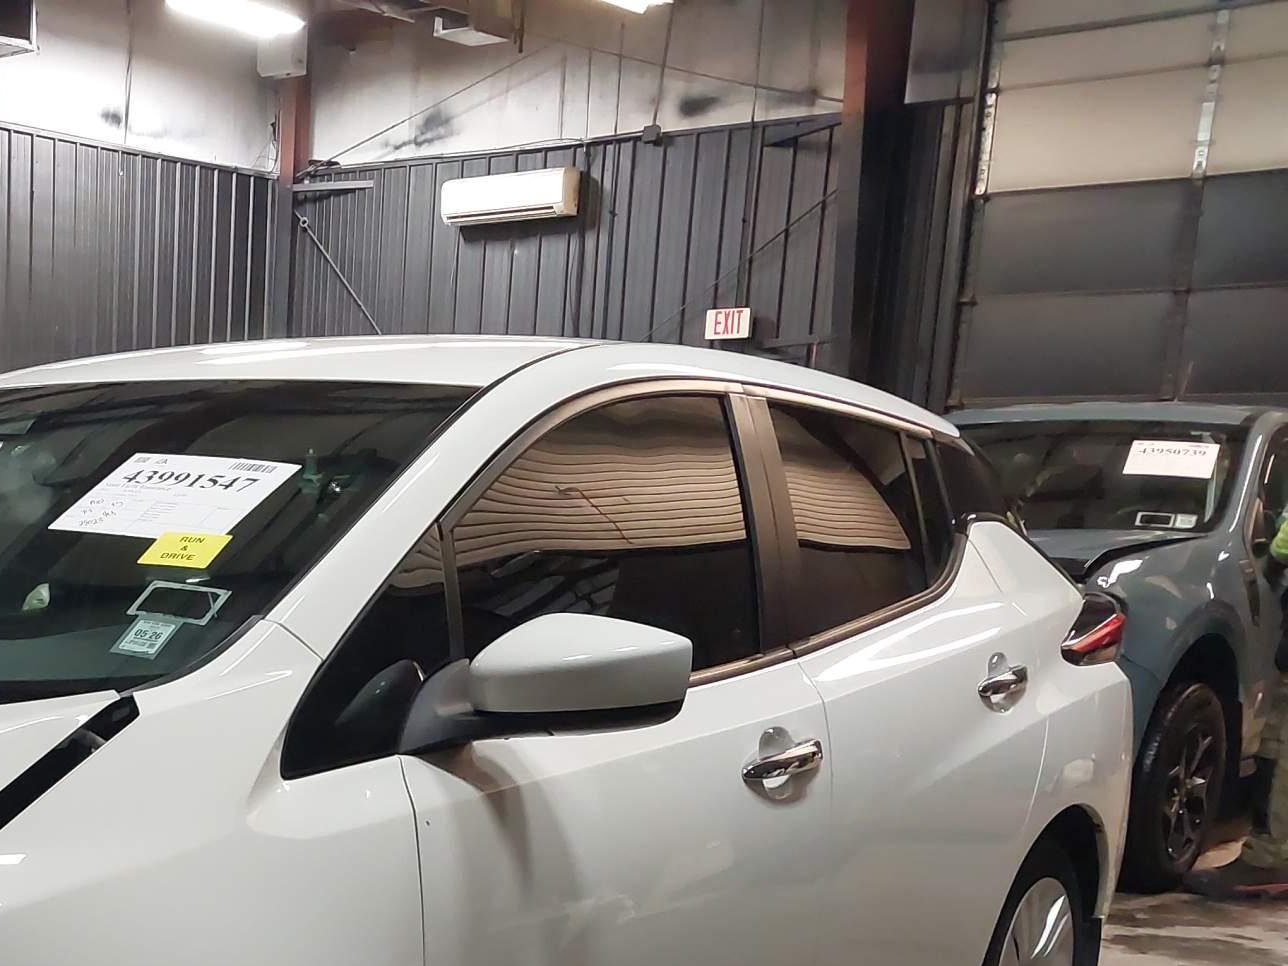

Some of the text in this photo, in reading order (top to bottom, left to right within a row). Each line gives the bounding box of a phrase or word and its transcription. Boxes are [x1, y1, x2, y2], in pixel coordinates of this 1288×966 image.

[714, 310, 744, 335] EXIT
[122, 469, 261, 492] 43991547
[179, 536, 206, 544] RUN
[160, 552, 196, 561] DRIVE
[134, 629, 164, 640] 05 26
